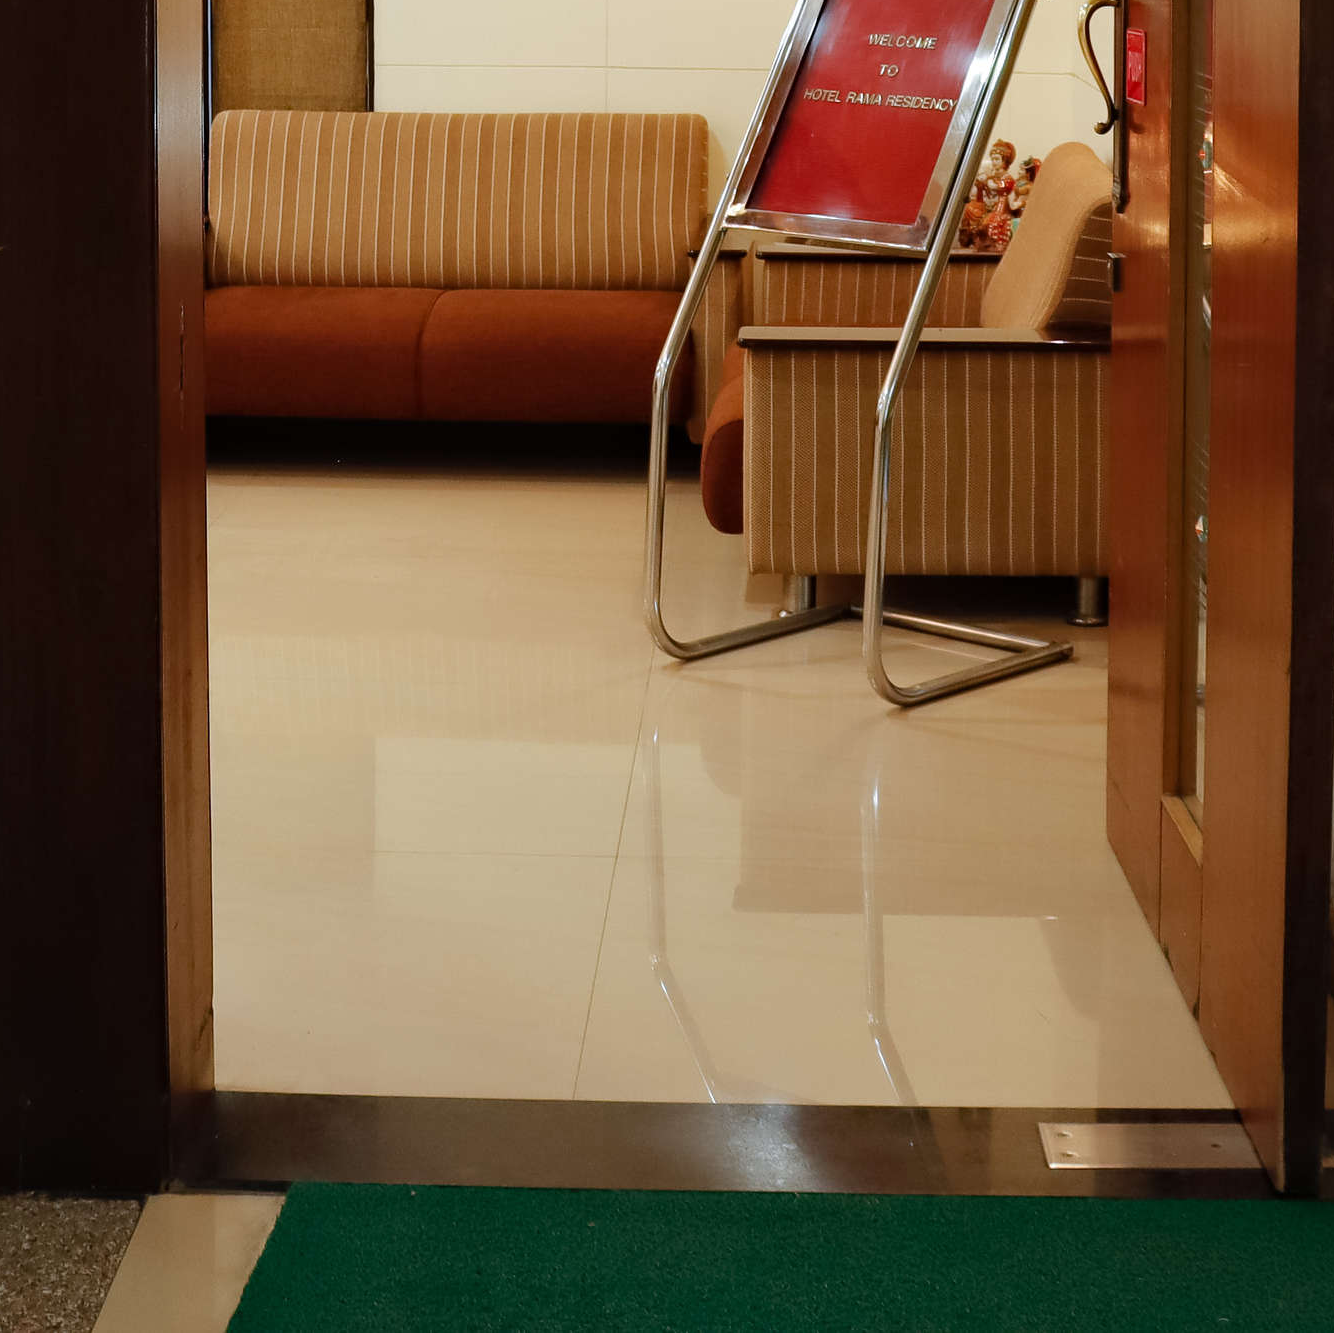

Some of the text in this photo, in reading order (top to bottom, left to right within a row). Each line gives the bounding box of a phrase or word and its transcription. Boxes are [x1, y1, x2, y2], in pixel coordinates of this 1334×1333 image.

[868, 33, 938, 50] WELCOME
[879, 64, 899, 78] TO
[803, 88, 958, 112] HOTEL RAMA RESIDENCY
